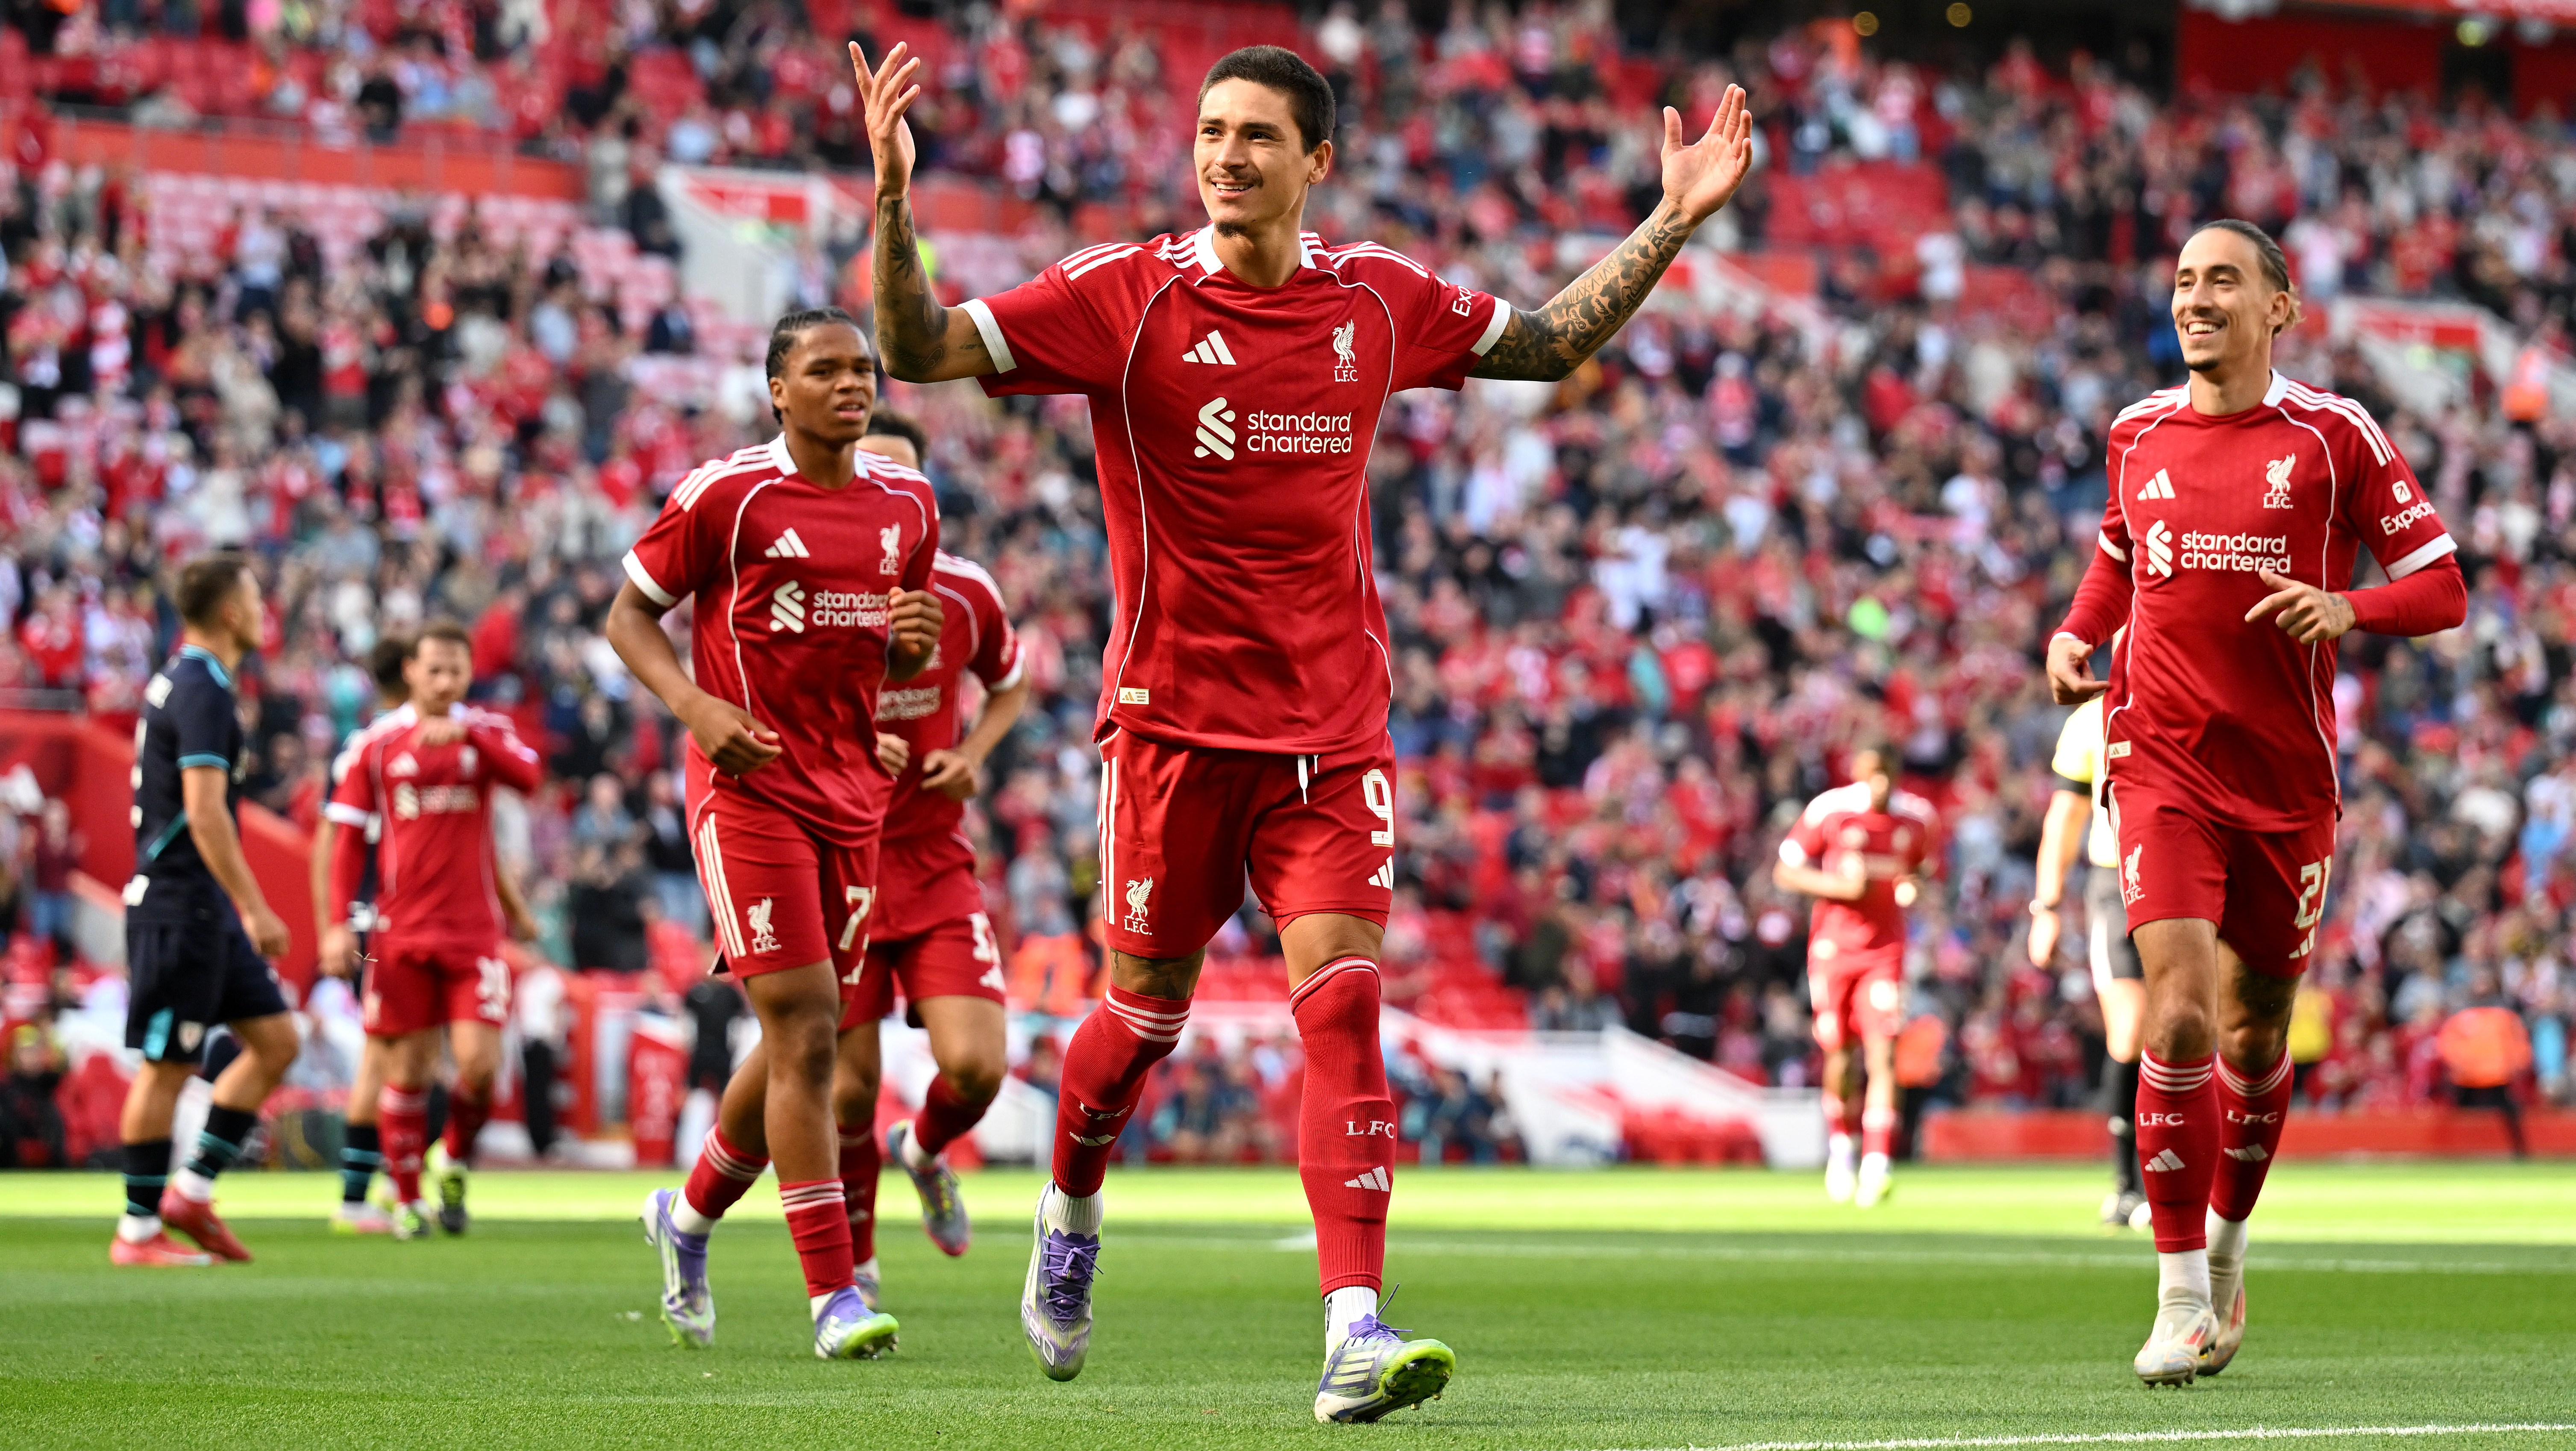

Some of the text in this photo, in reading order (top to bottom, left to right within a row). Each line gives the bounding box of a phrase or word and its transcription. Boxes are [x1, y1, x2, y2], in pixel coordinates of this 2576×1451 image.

[1248, 409, 1352, 432] standard
[1247, 431, 1352, 453] chartered
[2181, 530, 2287, 554] standard
[2180, 549, 2291, 574] chartered
[1362, 768, 1395, 848] 9
[2294, 854, 2332, 930] 21
[838, 885, 877, 953] 7
[1124, 918, 1152, 936] L.F.C.
[2138, 1112, 2185, 1127] LFC
[2226, 1109, 2279, 1126] LFC
[1346, 1120, 1395, 1139] LFC
